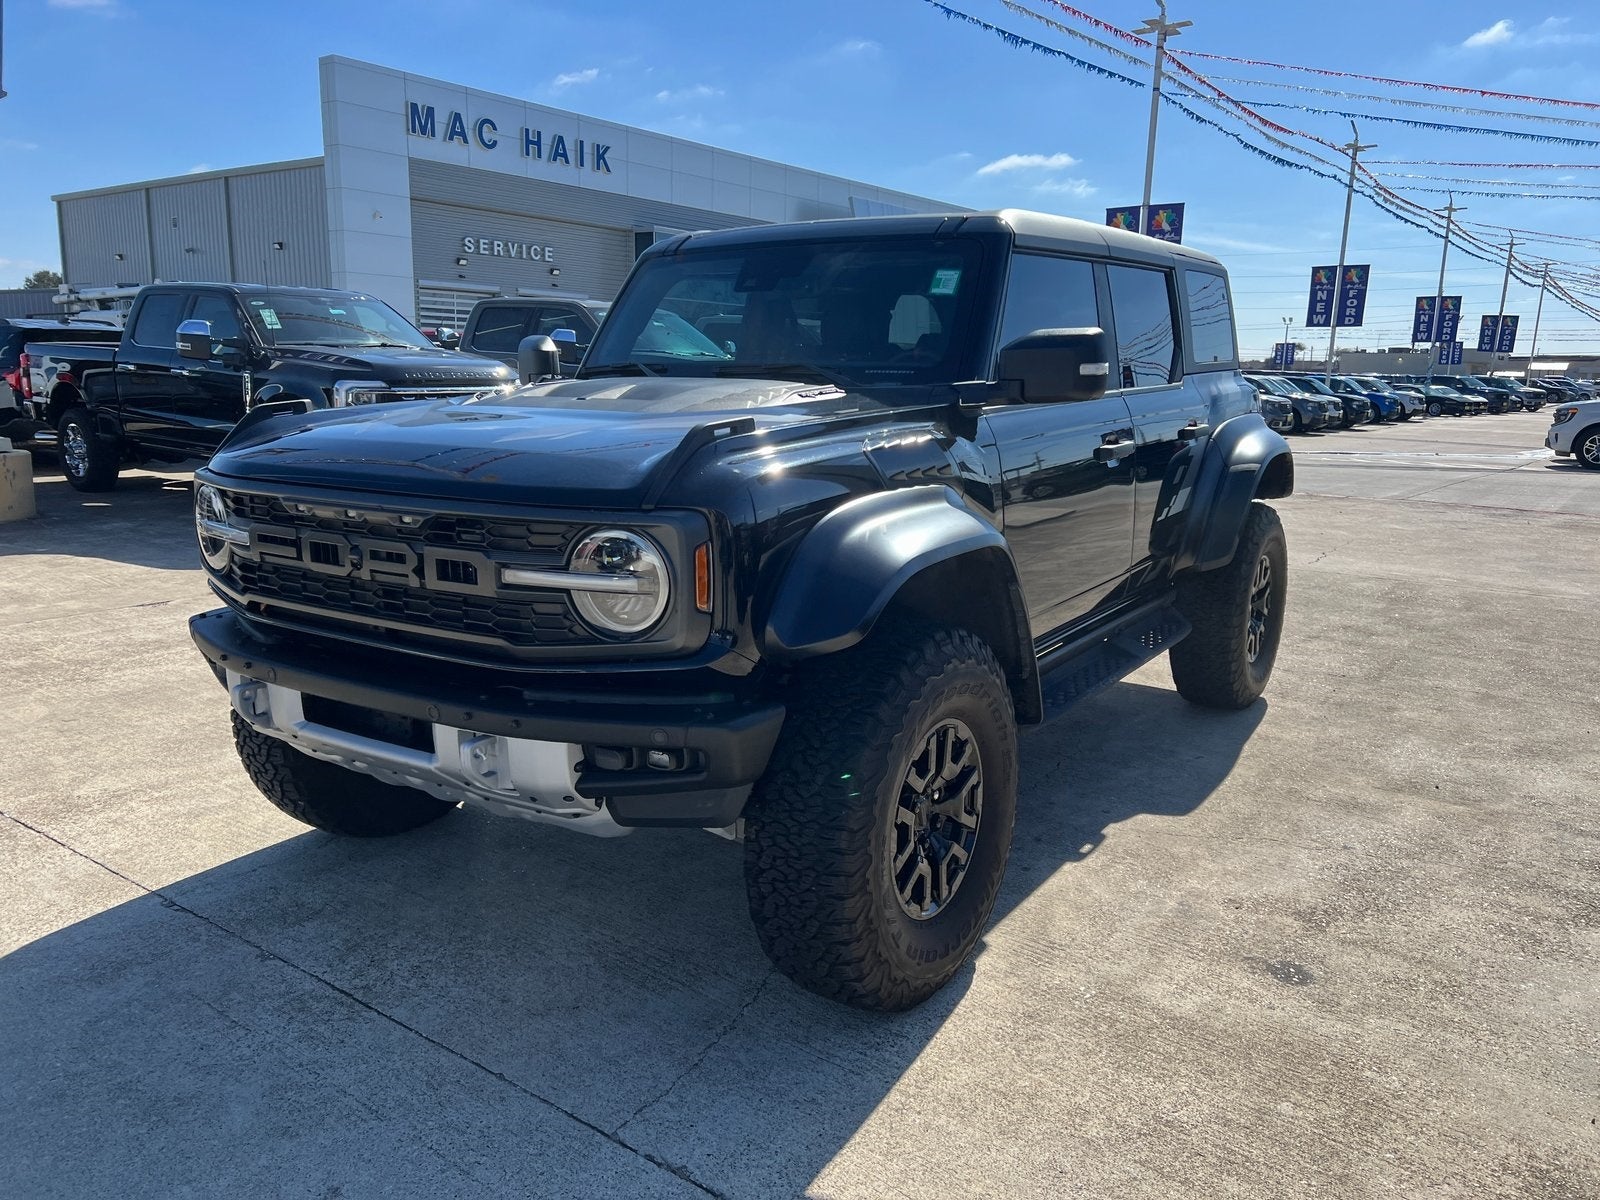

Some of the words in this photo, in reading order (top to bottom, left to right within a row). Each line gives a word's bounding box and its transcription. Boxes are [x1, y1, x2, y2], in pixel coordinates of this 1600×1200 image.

[407, 101, 498, 150] MAC
[522, 126, 612, 173] HAIK
[464, 237, 554, 262] SERVICE
[1312, 290, 1327, 325] NEW
[1344, 289, 1358, 325] FORD
[1416, 314, 1429, 340] NEW
[1441, 314, 1453, 341] FORD
[1481, 329, 1492, 350] NEW
[1502, 330, 1511, 351] FORD
[250, 522, 497, 597] FORD
